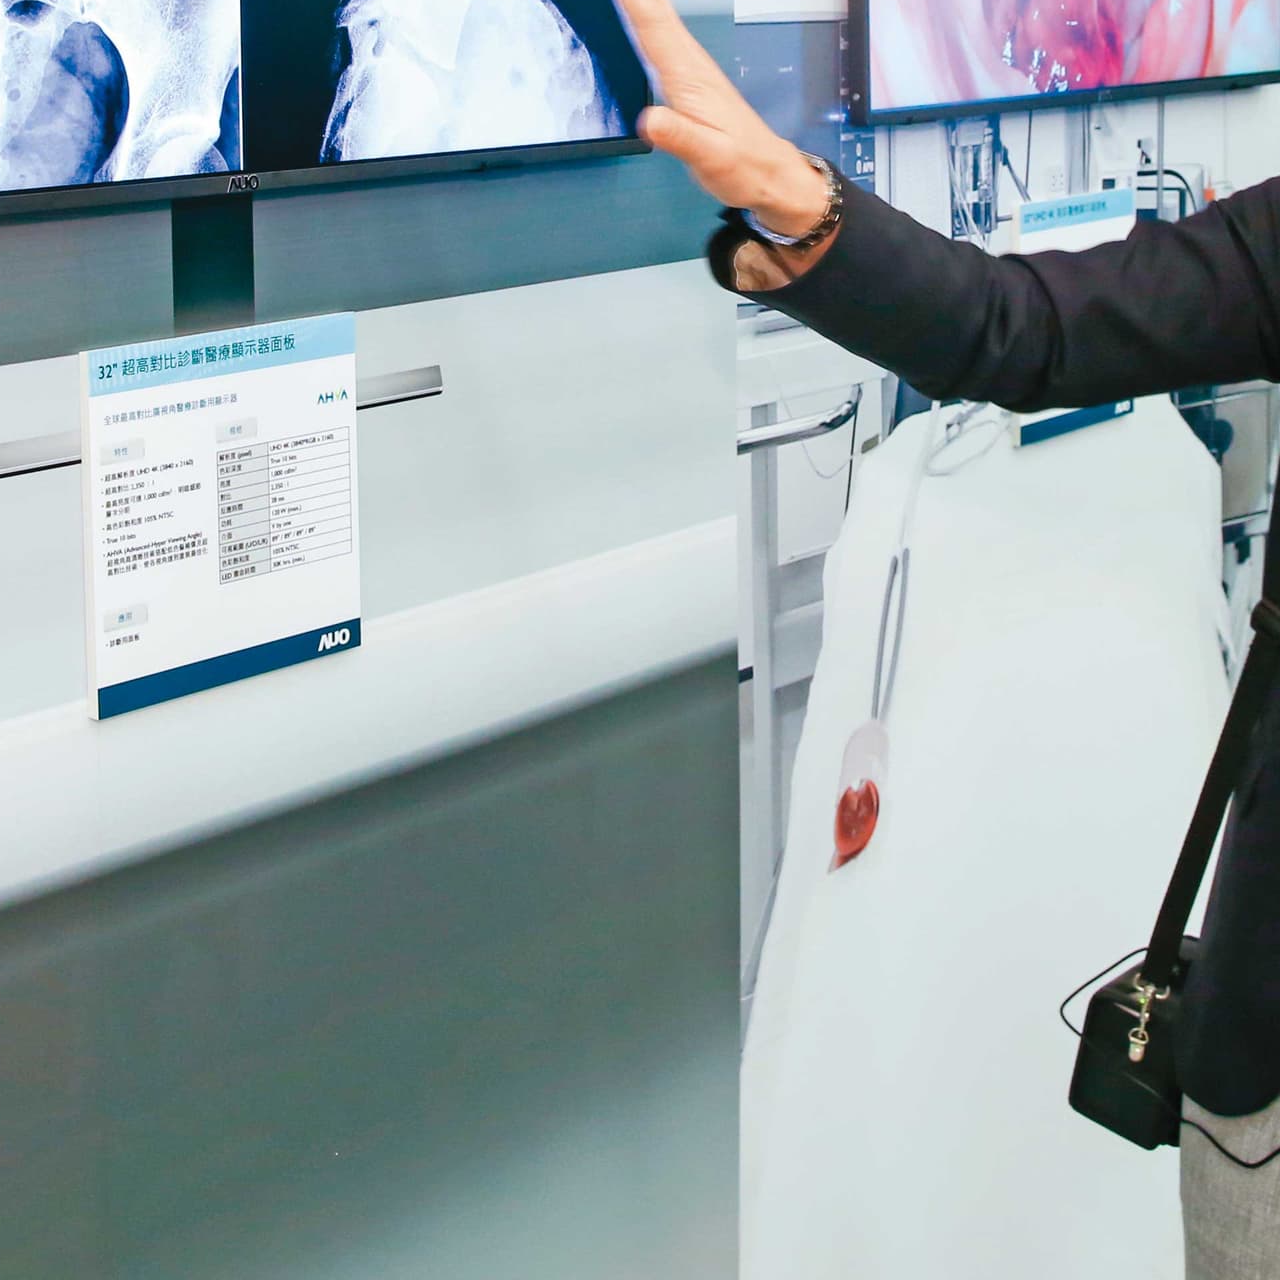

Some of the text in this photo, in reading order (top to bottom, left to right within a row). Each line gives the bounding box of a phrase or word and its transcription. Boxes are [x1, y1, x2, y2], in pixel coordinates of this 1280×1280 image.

[227, 173, 260, 193] AUO
[98, 333, 296, 380] 32" 超高對比診斷醫療顯示器面板
[318, 628, 350, 652] AUO
